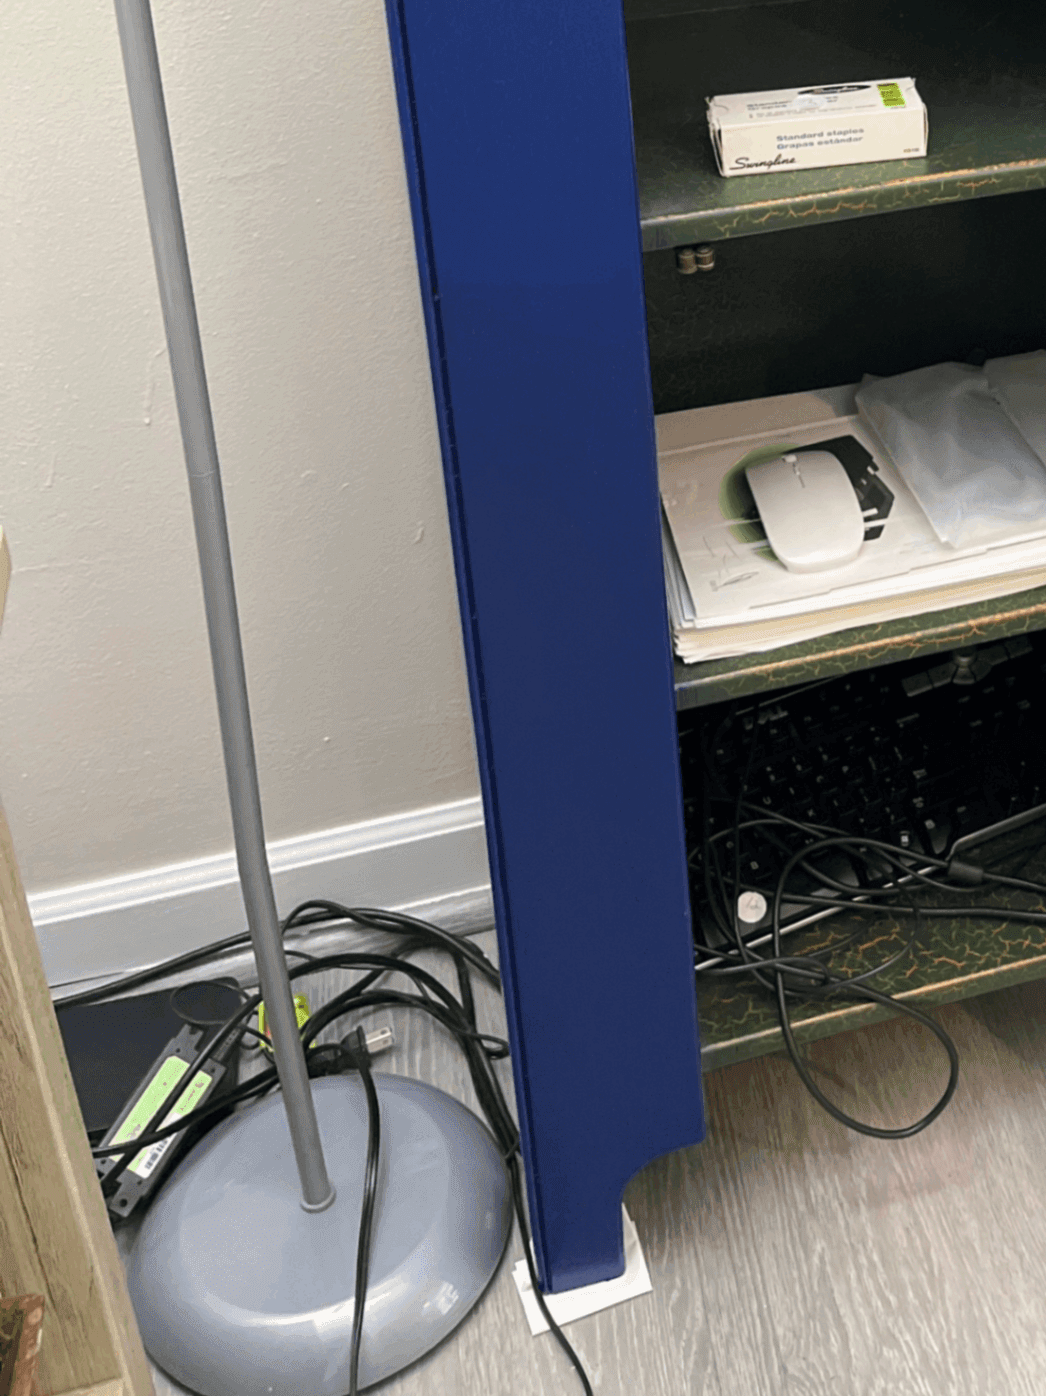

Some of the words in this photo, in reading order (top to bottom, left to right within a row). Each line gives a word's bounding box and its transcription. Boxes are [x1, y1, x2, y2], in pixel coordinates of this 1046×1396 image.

[776, 131, 824, 142] Standard
[826, 127, 865, 138] staples
[776, 140, 814, 151] Grapas
[729, 153, 797, 171] Swingline
